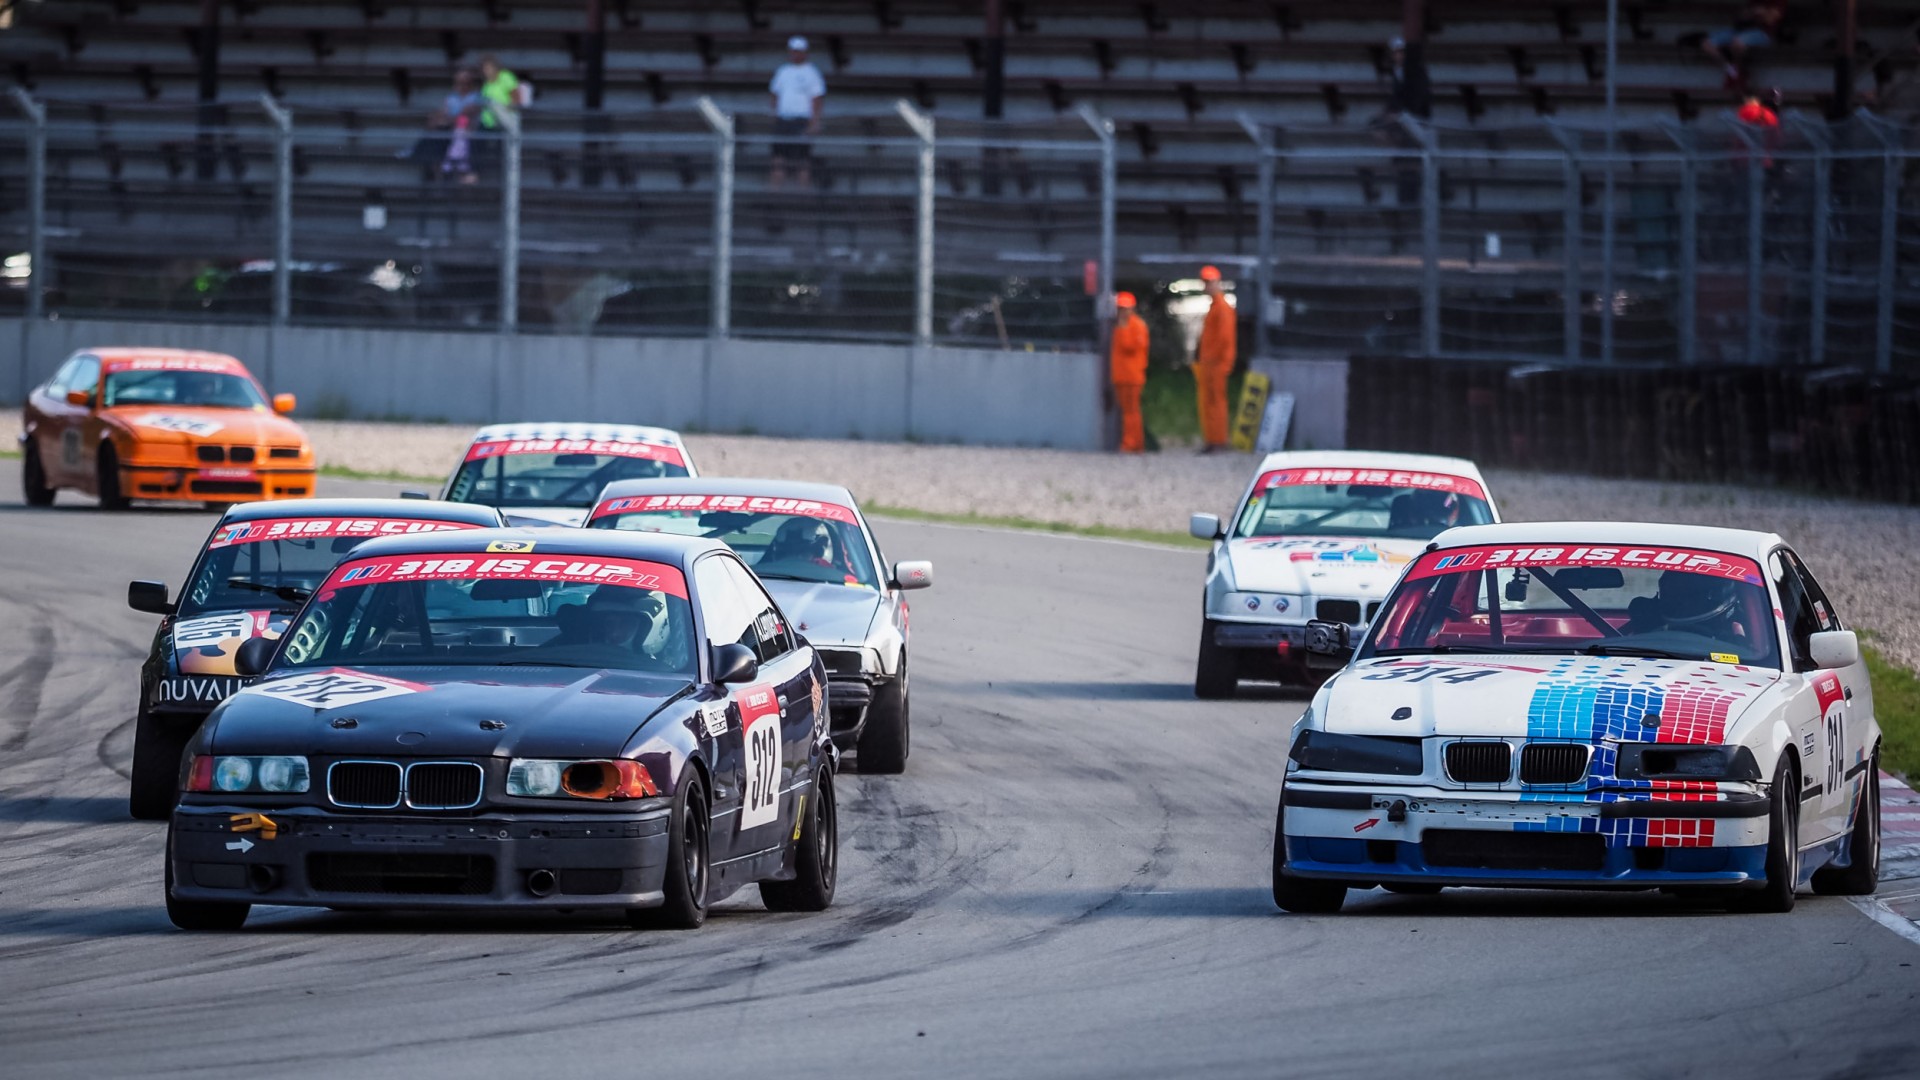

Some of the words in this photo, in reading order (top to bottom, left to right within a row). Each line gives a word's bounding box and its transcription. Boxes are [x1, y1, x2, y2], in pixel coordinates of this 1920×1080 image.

[590, 441, 652, 455] CUP
[1303, 470, 1354, 482] 318
[1356, 470, 1390, 482] IS
[1390, 472, 1454, 487] CUP
[645, 496, 706, 507] 318
[708, 496, 747, 507] IS
[748, 497, 822, 511] CUP
[267, 520, 333, 535] 318
[335, 520, 378, 532] IS
[1480, 560, 1562, 569] ZAWODNICY
[1484, 548, 1565, 563] 318
[1567, 548, 1620, 560] IS
[1622, 549, 1721, 567] CUP
[392, 559, 475, 575] 318
[476, 559, 531, 572] IS
[531, 560, 634, 577] CUP
[387, 573, 471, 581] ZAWODNICY
[1361, 665, 1502, 685] 314
[263, 676, 387, 703] 312
[1827, 712, 1844, 795] 314
[751, 726, 776, 811] 312
